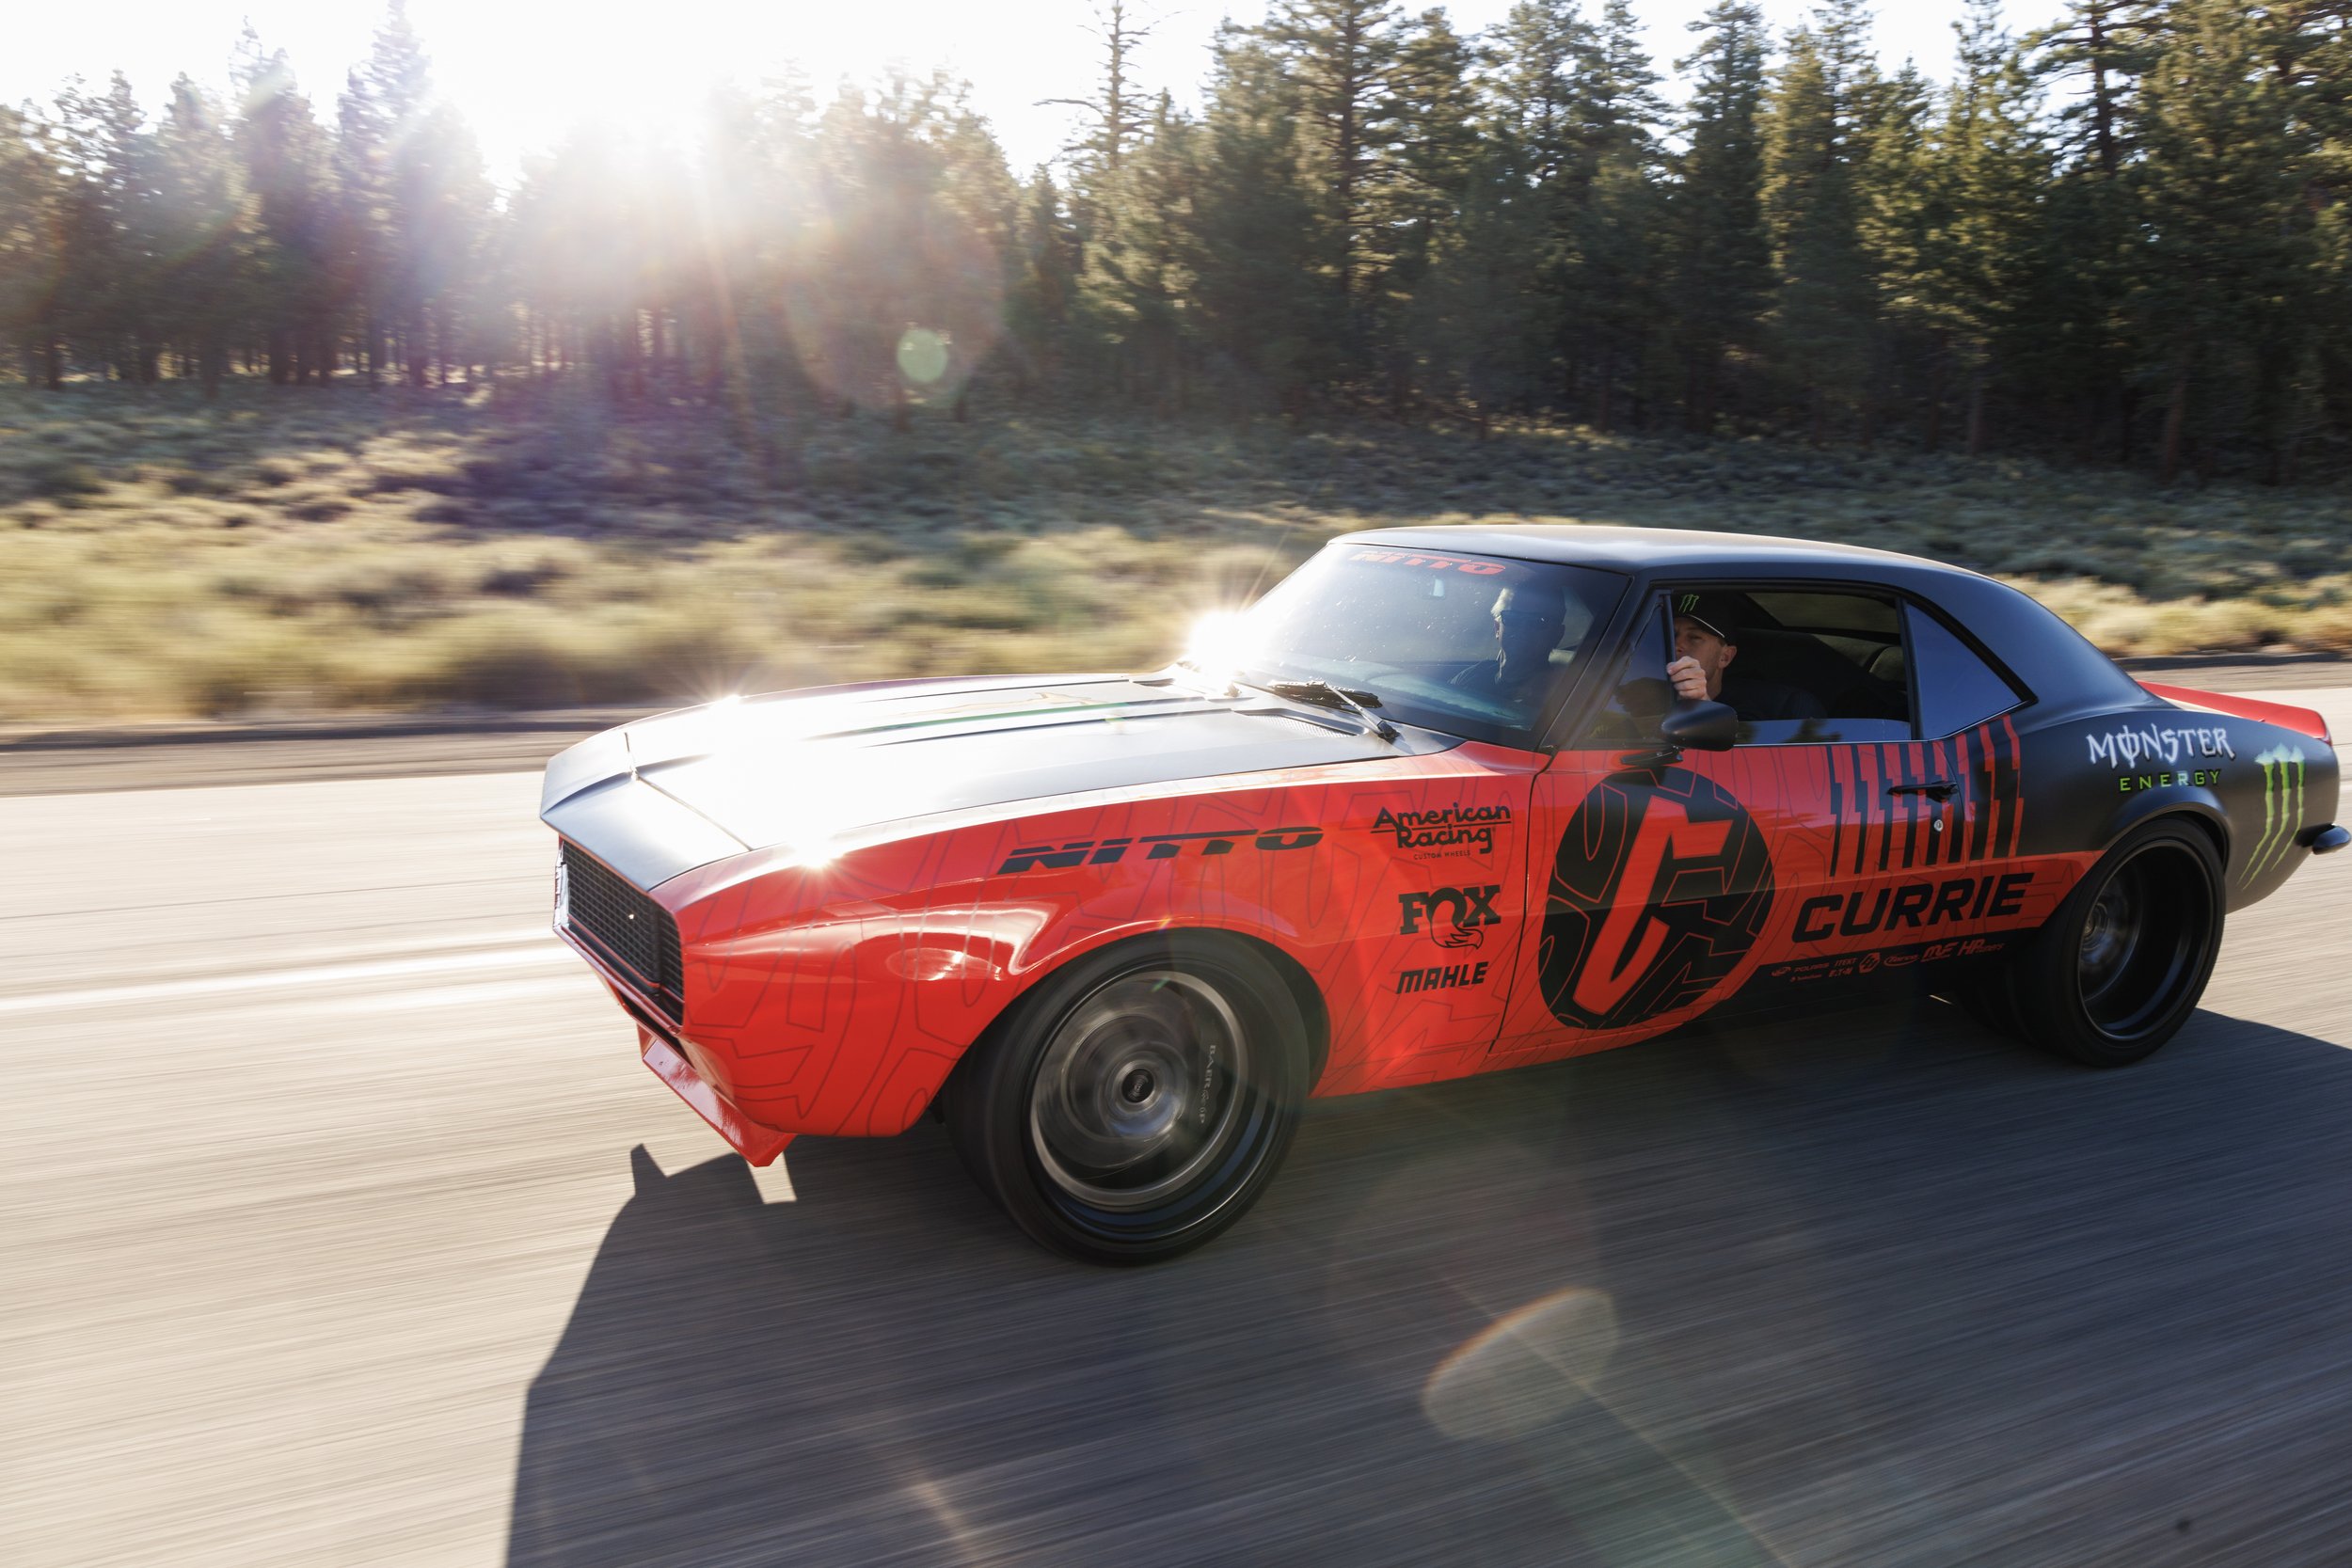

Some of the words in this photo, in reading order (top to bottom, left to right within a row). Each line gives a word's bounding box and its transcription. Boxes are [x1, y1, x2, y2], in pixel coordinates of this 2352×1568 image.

[1349, 550, 1505, 575] NITTO
[2120, 769, 2221, 792] ENERGY
[1372, 802, 1512, 829] American
[996, 827, 1324, 876] NITTO
[1396, 823, 1493, 855] Racing
[1413, 852, 1442, 861] CUSTOM
[1444, 849, 1471, 858] WHEELS
[1398, 885, 1502, 949] FOX
[1791, 873, 2035, 943] CURRIE
[1395, 961, 1489, 995] MAHLE
